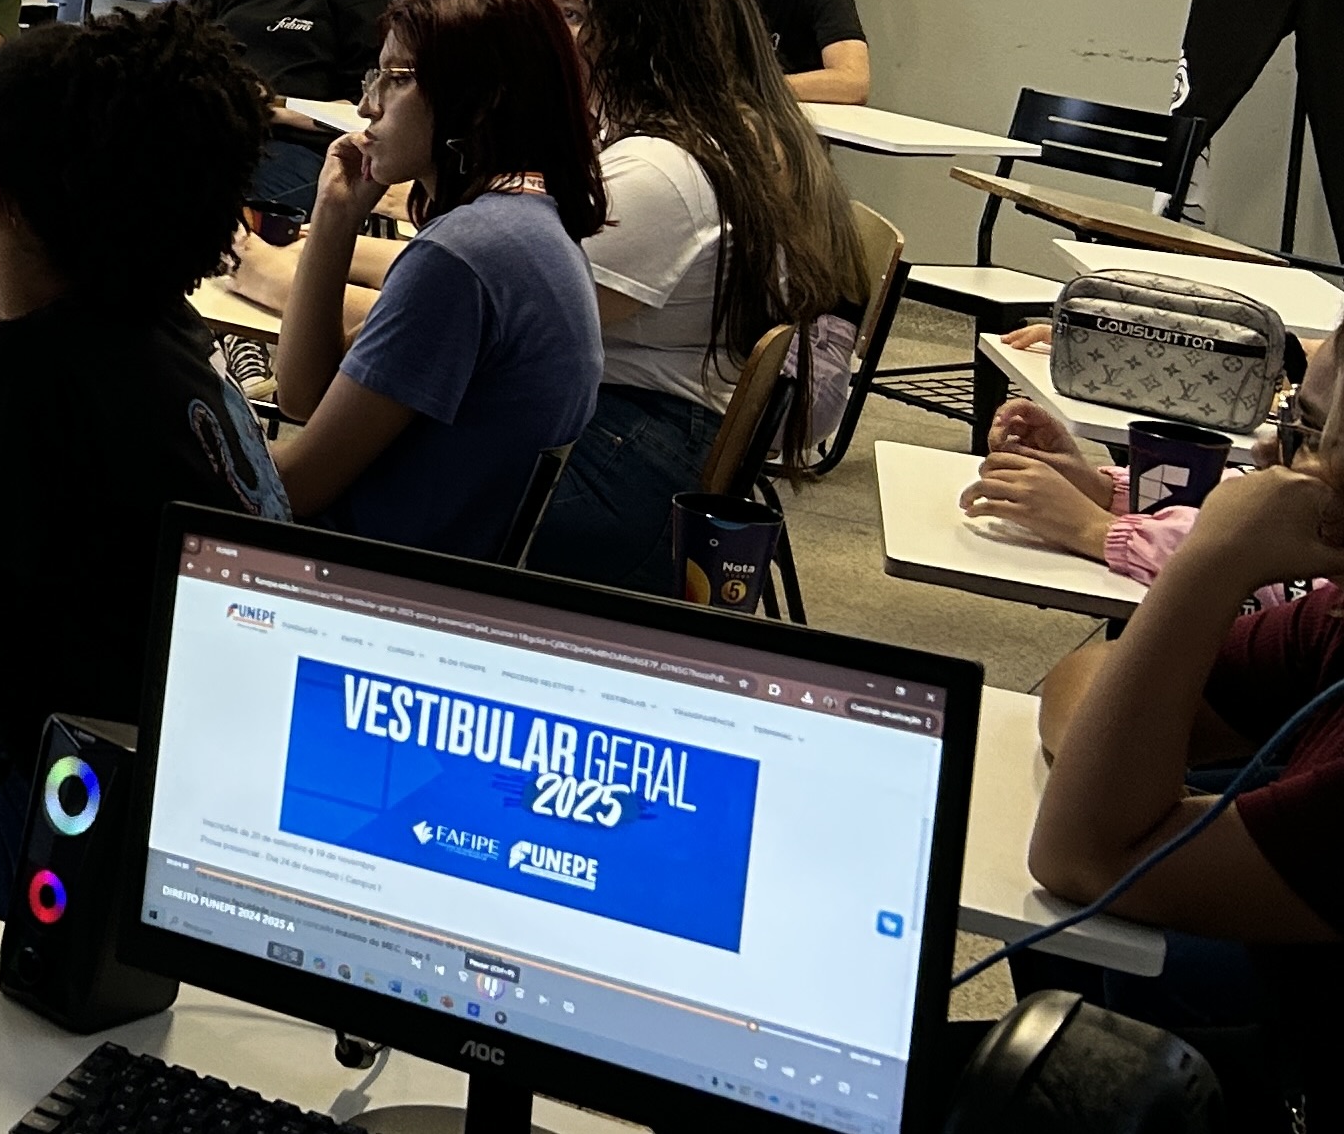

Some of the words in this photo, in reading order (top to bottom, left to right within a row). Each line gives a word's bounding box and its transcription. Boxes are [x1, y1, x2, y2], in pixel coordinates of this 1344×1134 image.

[722, 561, 756, 574] Nota
[344, 674, 577, 777] VESTIBULAR
[584, 730, 697, 812] GERAL
[531, 771, 631, 828] 2025
[436, 825, 501, 855] FAFIPE
[508, 840, 599, 883] FUNEPE
[163, 885, 199, 905] DIREITO
[237, 907, 261, 922] 2024
[261, 914, 285, 931] 2025
[286, 921, 295, 933] A
[460, 1040, 506, 1066] AOC
